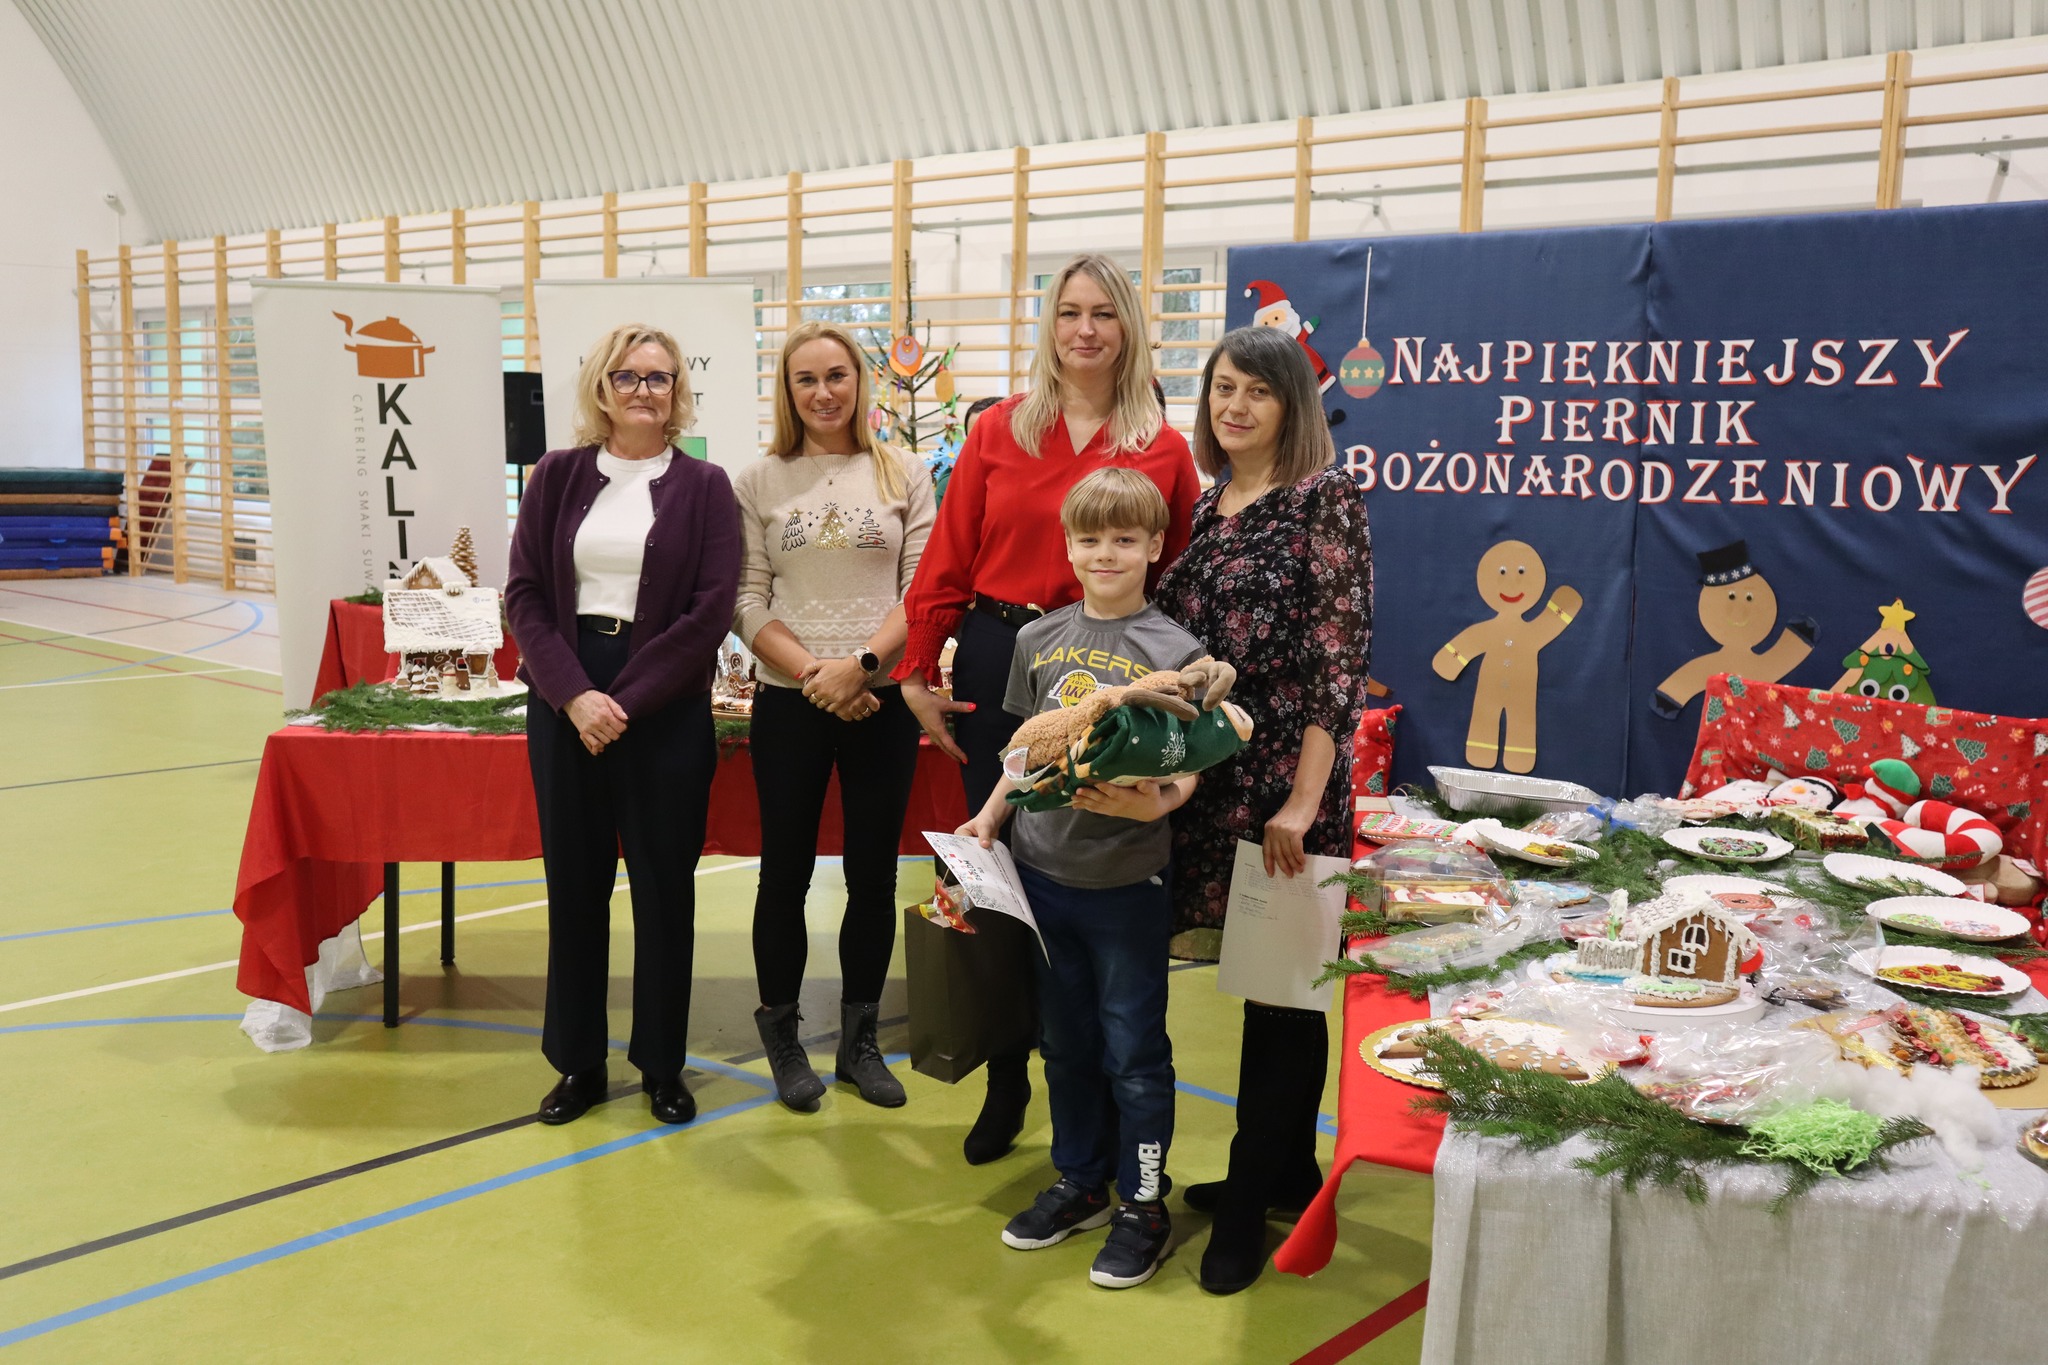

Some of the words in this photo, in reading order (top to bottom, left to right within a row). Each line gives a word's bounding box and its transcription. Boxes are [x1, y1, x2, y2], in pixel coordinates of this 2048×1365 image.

[352, 393, 368, 477] CATERING
[1495, 395, 1760, 446] PIERNIK
[1344, 439, 2038, 515] BOŻONARODZENIOWY
[358, 490, 372, 538] SMAKI
[1033, 646, 1153, 682] LAKERS
[1053, 678, 1097, 698] LAKE
[1134, 1141, 1161, 1202] MARVEL
